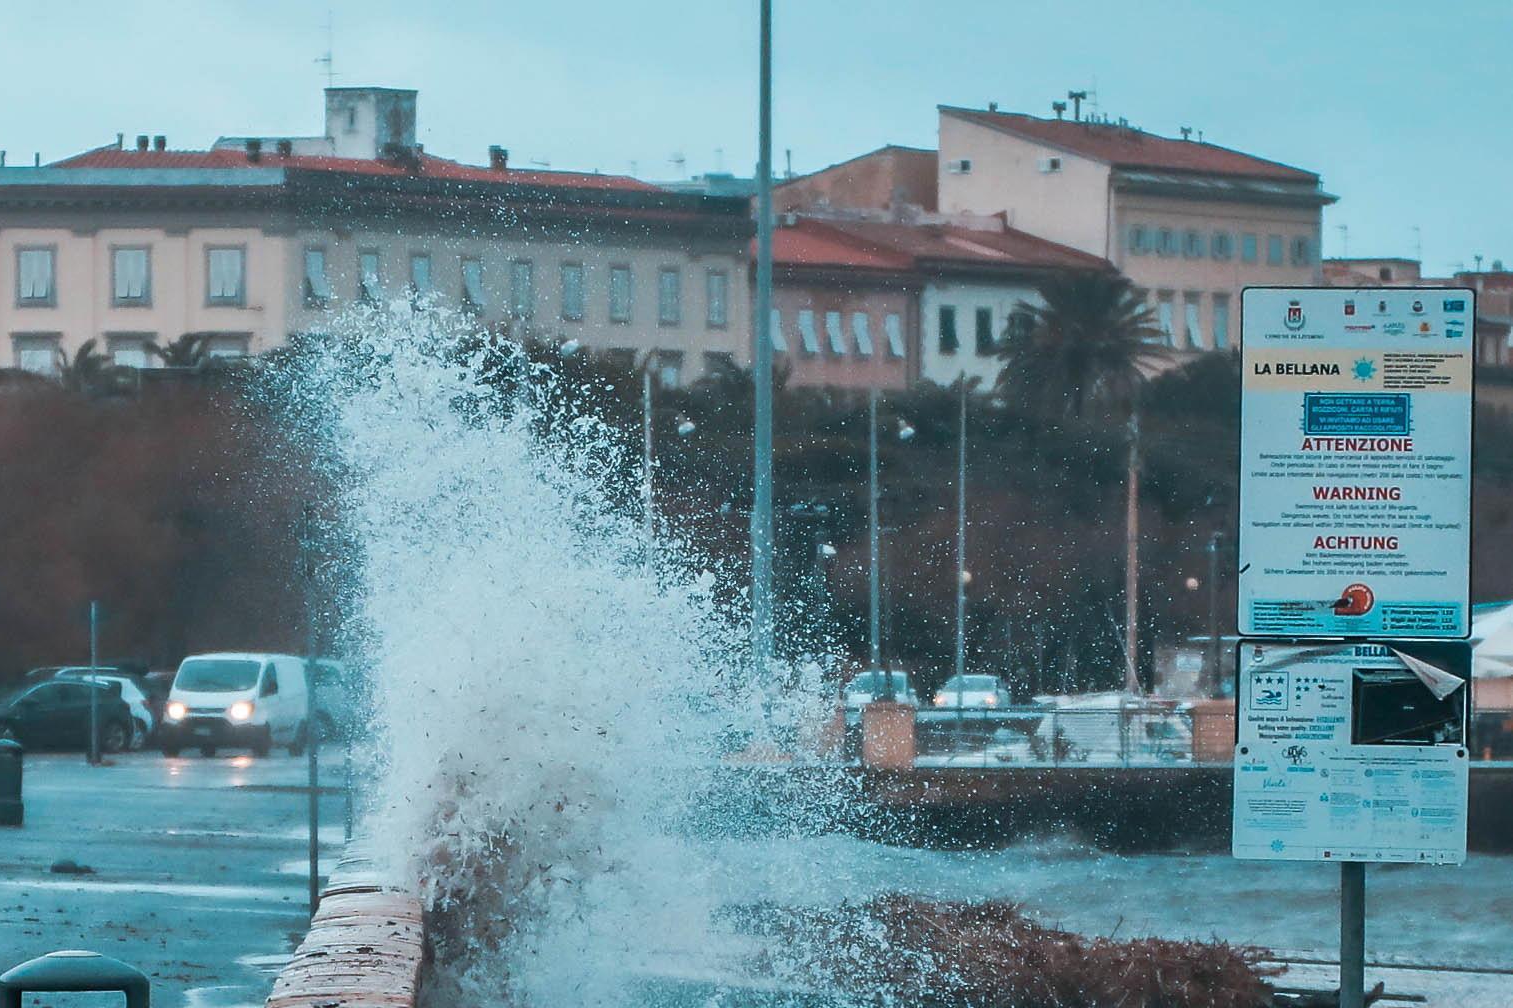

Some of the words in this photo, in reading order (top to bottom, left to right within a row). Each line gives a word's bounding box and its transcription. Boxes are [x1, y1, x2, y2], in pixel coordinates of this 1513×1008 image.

[1254, 363, 1271, 375] LA
[1276, 363, 1340, 375] BELLANA
[1301, 438, 1412, 451] ATTENZIONE
[1313, 487, 1401, 500] WARNING
[1314, 536, 1398, 550] ACHTUNG
